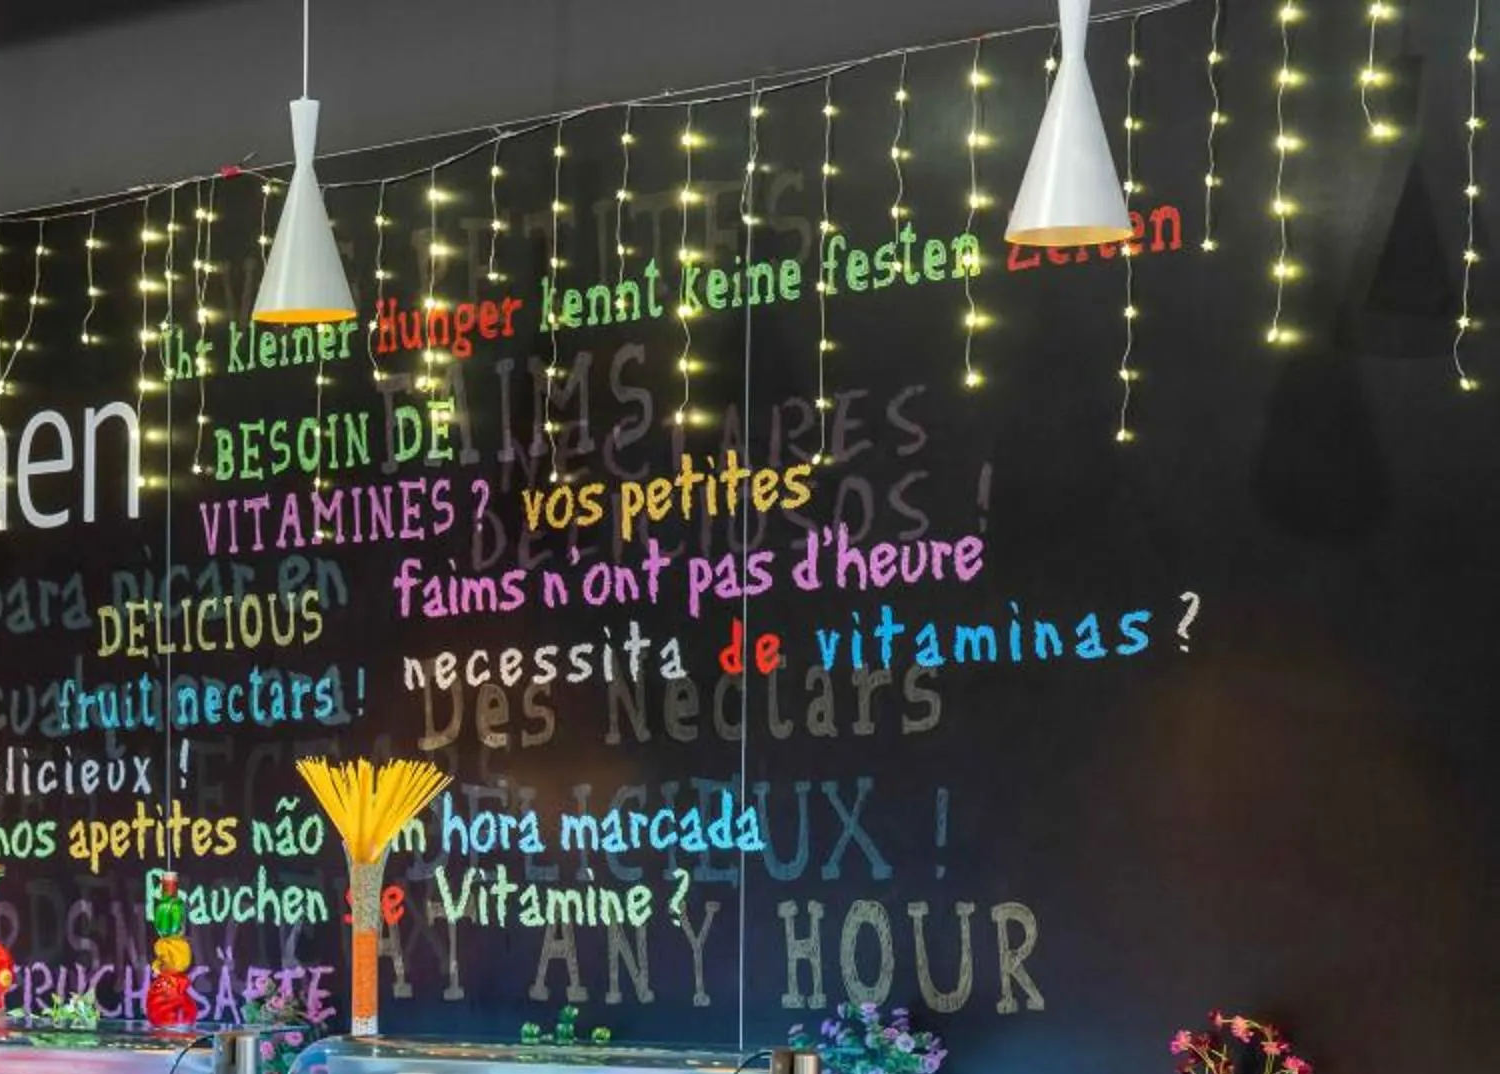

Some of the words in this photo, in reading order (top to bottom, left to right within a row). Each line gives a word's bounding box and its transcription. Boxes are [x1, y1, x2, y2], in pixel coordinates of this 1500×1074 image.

[227, 321, 359, 373] kleiner
[376, 297, 523, 359] Hunger
[539, 258, 664, 332] kennt
[682, 252, 802, 310] keine
[822, 221, 982, 295] festen
[213, 411, 369, 481] BESOIN
[393, 398, 456, 463] DE
[200, 478, 456, 556] VITAMINES
[522, 482, 605, 532] vos
[621, 450, 813, 543] petites
[392, 558, 526, 618] faims
[543, 525, 670, 608] n'ont
[689, 550, 775, 619] pas
[791, 521, 985, 592] d'heure
[96, 590, 324, 660] DELICIOUS
[403, 620, 688, 691] necessita
[718, 617, 781, 676] de
[815, 602, 1154, 671] vitaminas
[56, 672, 157, 732] fruit
[175, 664, 335, 728] nectars
[417, 656, 556, 752] Des
[68, 799, 238, 874] apetites
[251, 798, 325, 857] não
[439, 791, 545, 854] hora
[561, 789, 766, 853] marcada
[145, 865, 329, 926] Bauchen
[436, 863, 653, 927] Vitamine
[776, 899, 1045, 1014] HOUR
